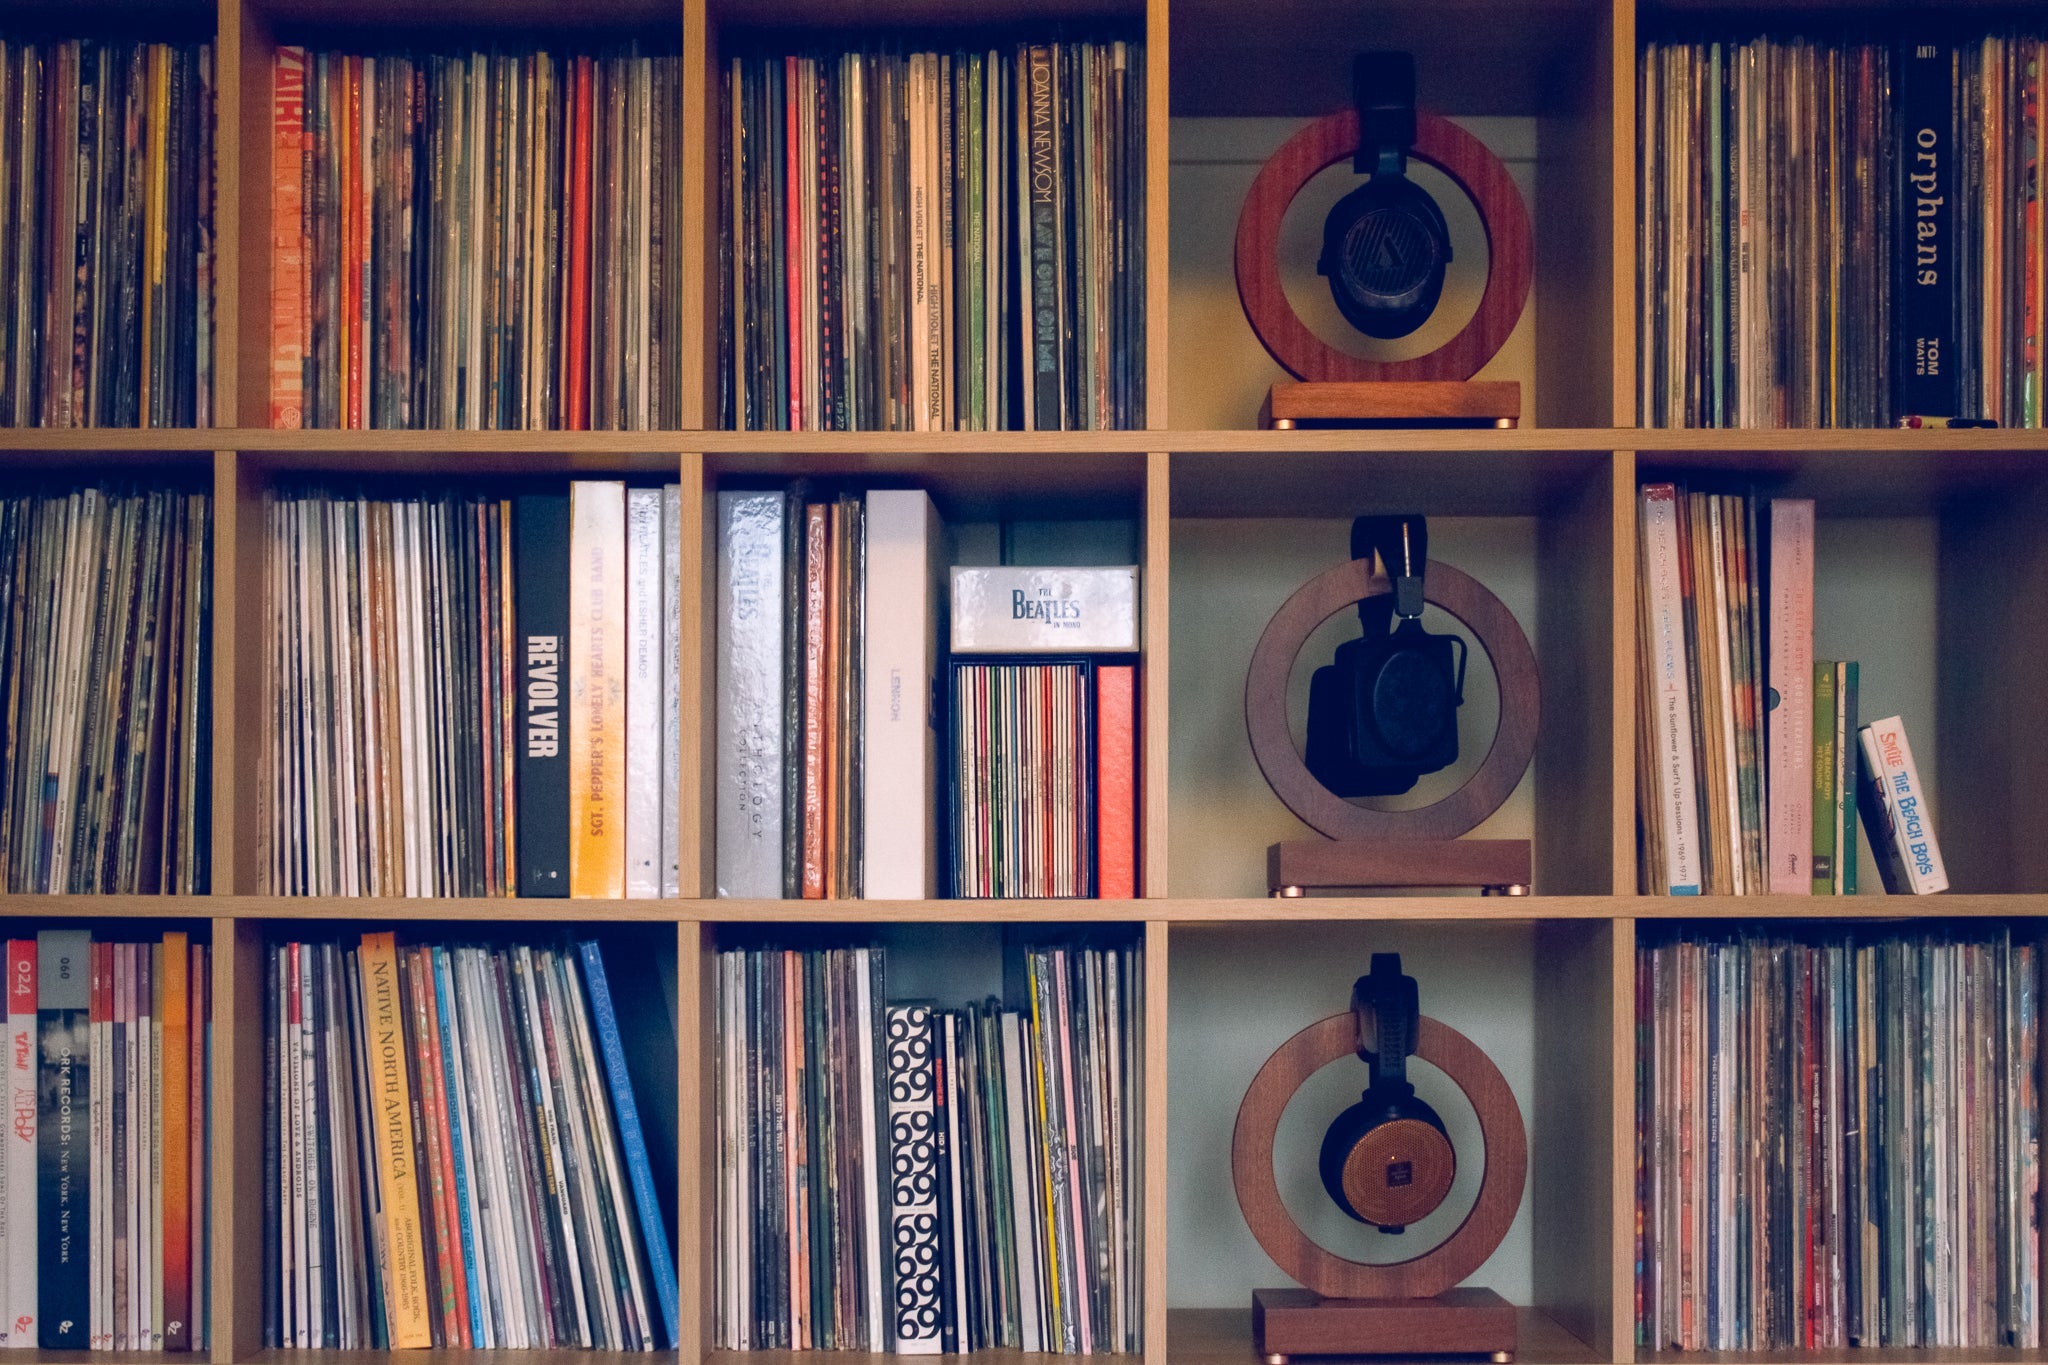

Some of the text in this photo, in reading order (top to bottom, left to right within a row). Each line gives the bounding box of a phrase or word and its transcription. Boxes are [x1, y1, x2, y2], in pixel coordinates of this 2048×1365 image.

[1032, 59, 1053, 204] JOANNA NEWSOM
[1909, 128, 1943, 287] orphans
[915, 186, 924, 304] HIGH VIOLET THE NATIONAL
[973, 211, 981, 265] THE NATIONAL
[1036, 263, 1055, 307] ONE
[1037, 309, 1055, 342] ON
[930, 284, 940, 420] HIGH VIOLET THE NATIONAL
[1038, 343, 1056, 373] ME
[1915, 338, 1926, 376] WAITS
[1926, 338, 1940, 376] TOM
[638, 578, 648, 598] and
[737, 543, 773, 620] BEATLES
[1038, 588, 1053, 596] THE
[638, 599, 648, 637] ESHER
[1012, 589, 1081, 625] BEATLES
[638, 639, 648, 679] DEMOS
[527, 635, 559, 758] REVOLVER
[590, 547, 604, 838] SGT. PEPPER'S LONELY HEARTS CLUB BAND
[890, 669, 901, 722] LENNON
[1669, 696, 1677, 712] The
[1670, 713, 1679, 753] Sunflower
[1793, 709, 1805, 770] VIBRATIONS
[1672, 764, 1682, 786] Surf's
[1672, 788, 1682, 799] Up
[1892, 772, 1910, 795] THE
[1674, 801, 1684, 835] Sessions
[1897, 796, 1924, 839] BEACH
[1910, 843, 1933, 875] BOYS
[15, 960, 31, 996] 024
[60, 957, 70, 979] 060
[61, 1047, 71, 1074] ORK
[372, 960, 407, 1180] NATIVE NORTH AMERICA
[936, 1058, 944, 1107] RADIOHEAD
[61, 1078, 71, 1145] RECORDS:
[294, 1098, 300, 1109] OF
[775, 1094, 783, 1113] INTO
[441, 1024, 473, 1270] SERGE GAINSBOURG HISTOIRE DE MELODY NELSON
[539, 1122, 550, 1154] LAUGHTER
[549, 1123, 557, 1145] FRANK
[61, 1150, 70, 1171] NEW
[306, 1124, 318, 1229] SWITCHED ON EUGENE
[557, 1180, 569, 1215] VANGUARD
[61, 1210, 70, 1232] NEW
[61, 1235, 70, 1263] YORK
[396, 1232, 406, 1273] COUNTRY
[404, 1217, 417, 1268] ABORIGINAL
